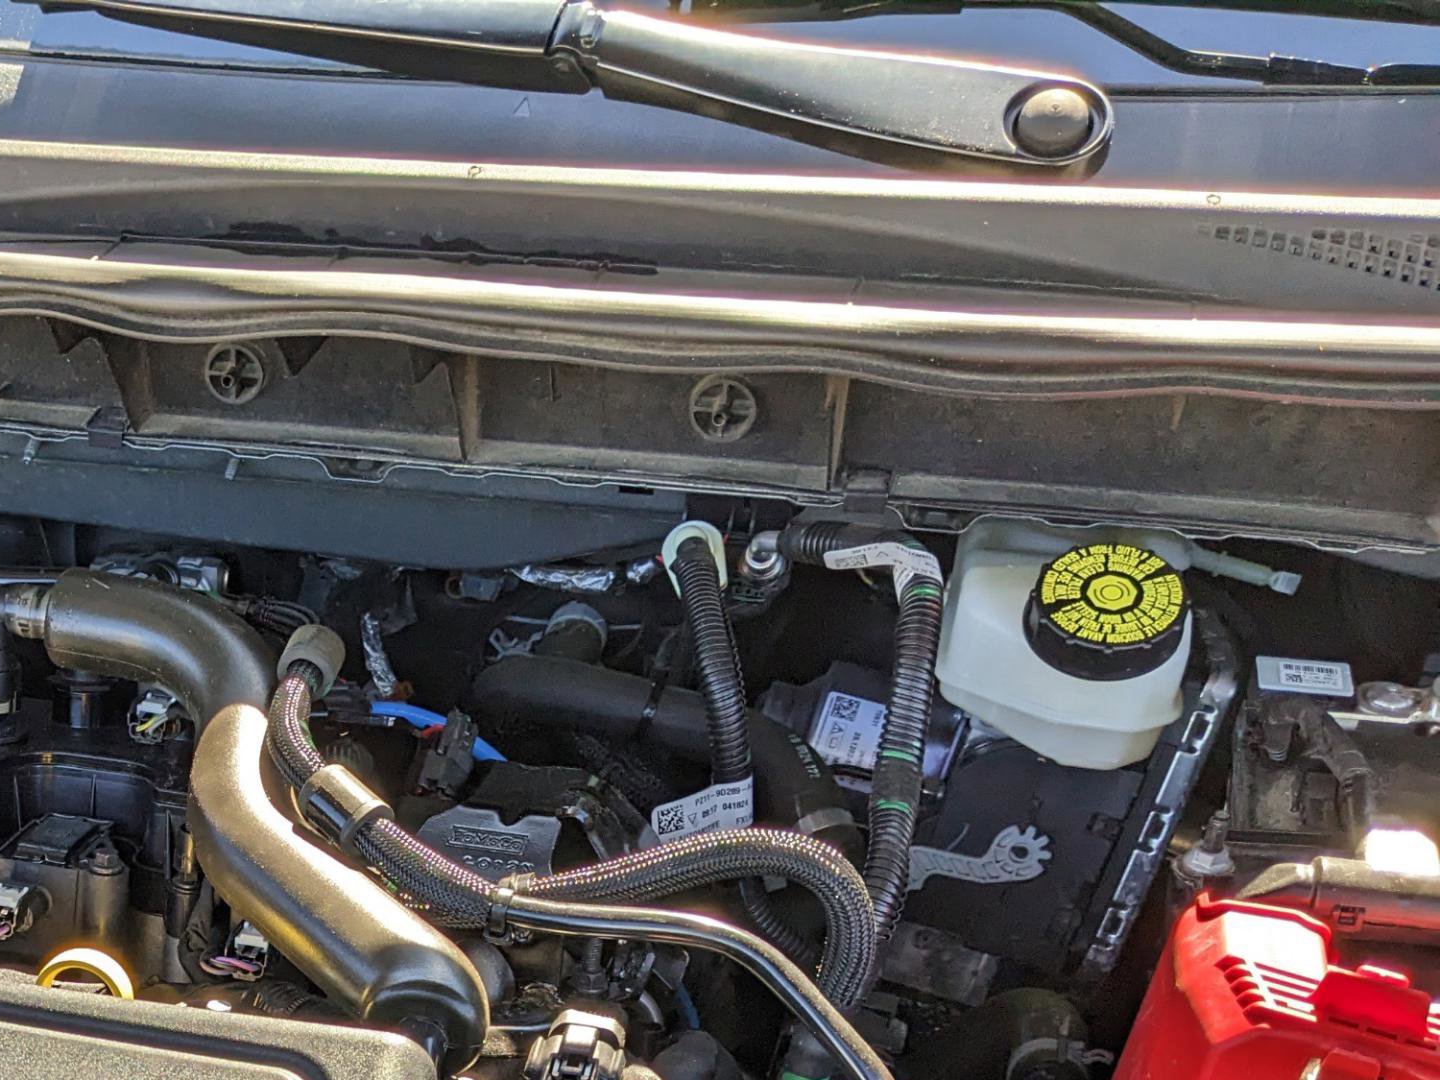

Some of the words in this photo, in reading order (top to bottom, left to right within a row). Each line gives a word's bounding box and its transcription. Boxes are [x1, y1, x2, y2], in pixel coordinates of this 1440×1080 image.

[1078, 549, 1088, 557] A
[1088, 545, 1112, 555] FROM
[1115, 545, 1141, 557] FLUID
[1052, 552, 1080, 571] SEALED
[1107, 554, 1140, 568] BEFORE
[1145, 556, 1166, 569] DOT
[1077, 563, 1105, 579] CLEAN
[1137, 563, 1156, 575] CAP
[1057, 571, 1073, 584] USE
[1041, 570, 1059, 604] CONTAINER
[1068, 577, 1085, 599] FILLER
[1078, 617, 1101, 632] FREIN
[1101, 623, 1112, 634] DE
[1076, 628, 1105, 642] AVANT
[1106, 630, 1145, 643] BOUCHON
[1143, 626, 1157, 637] LE
